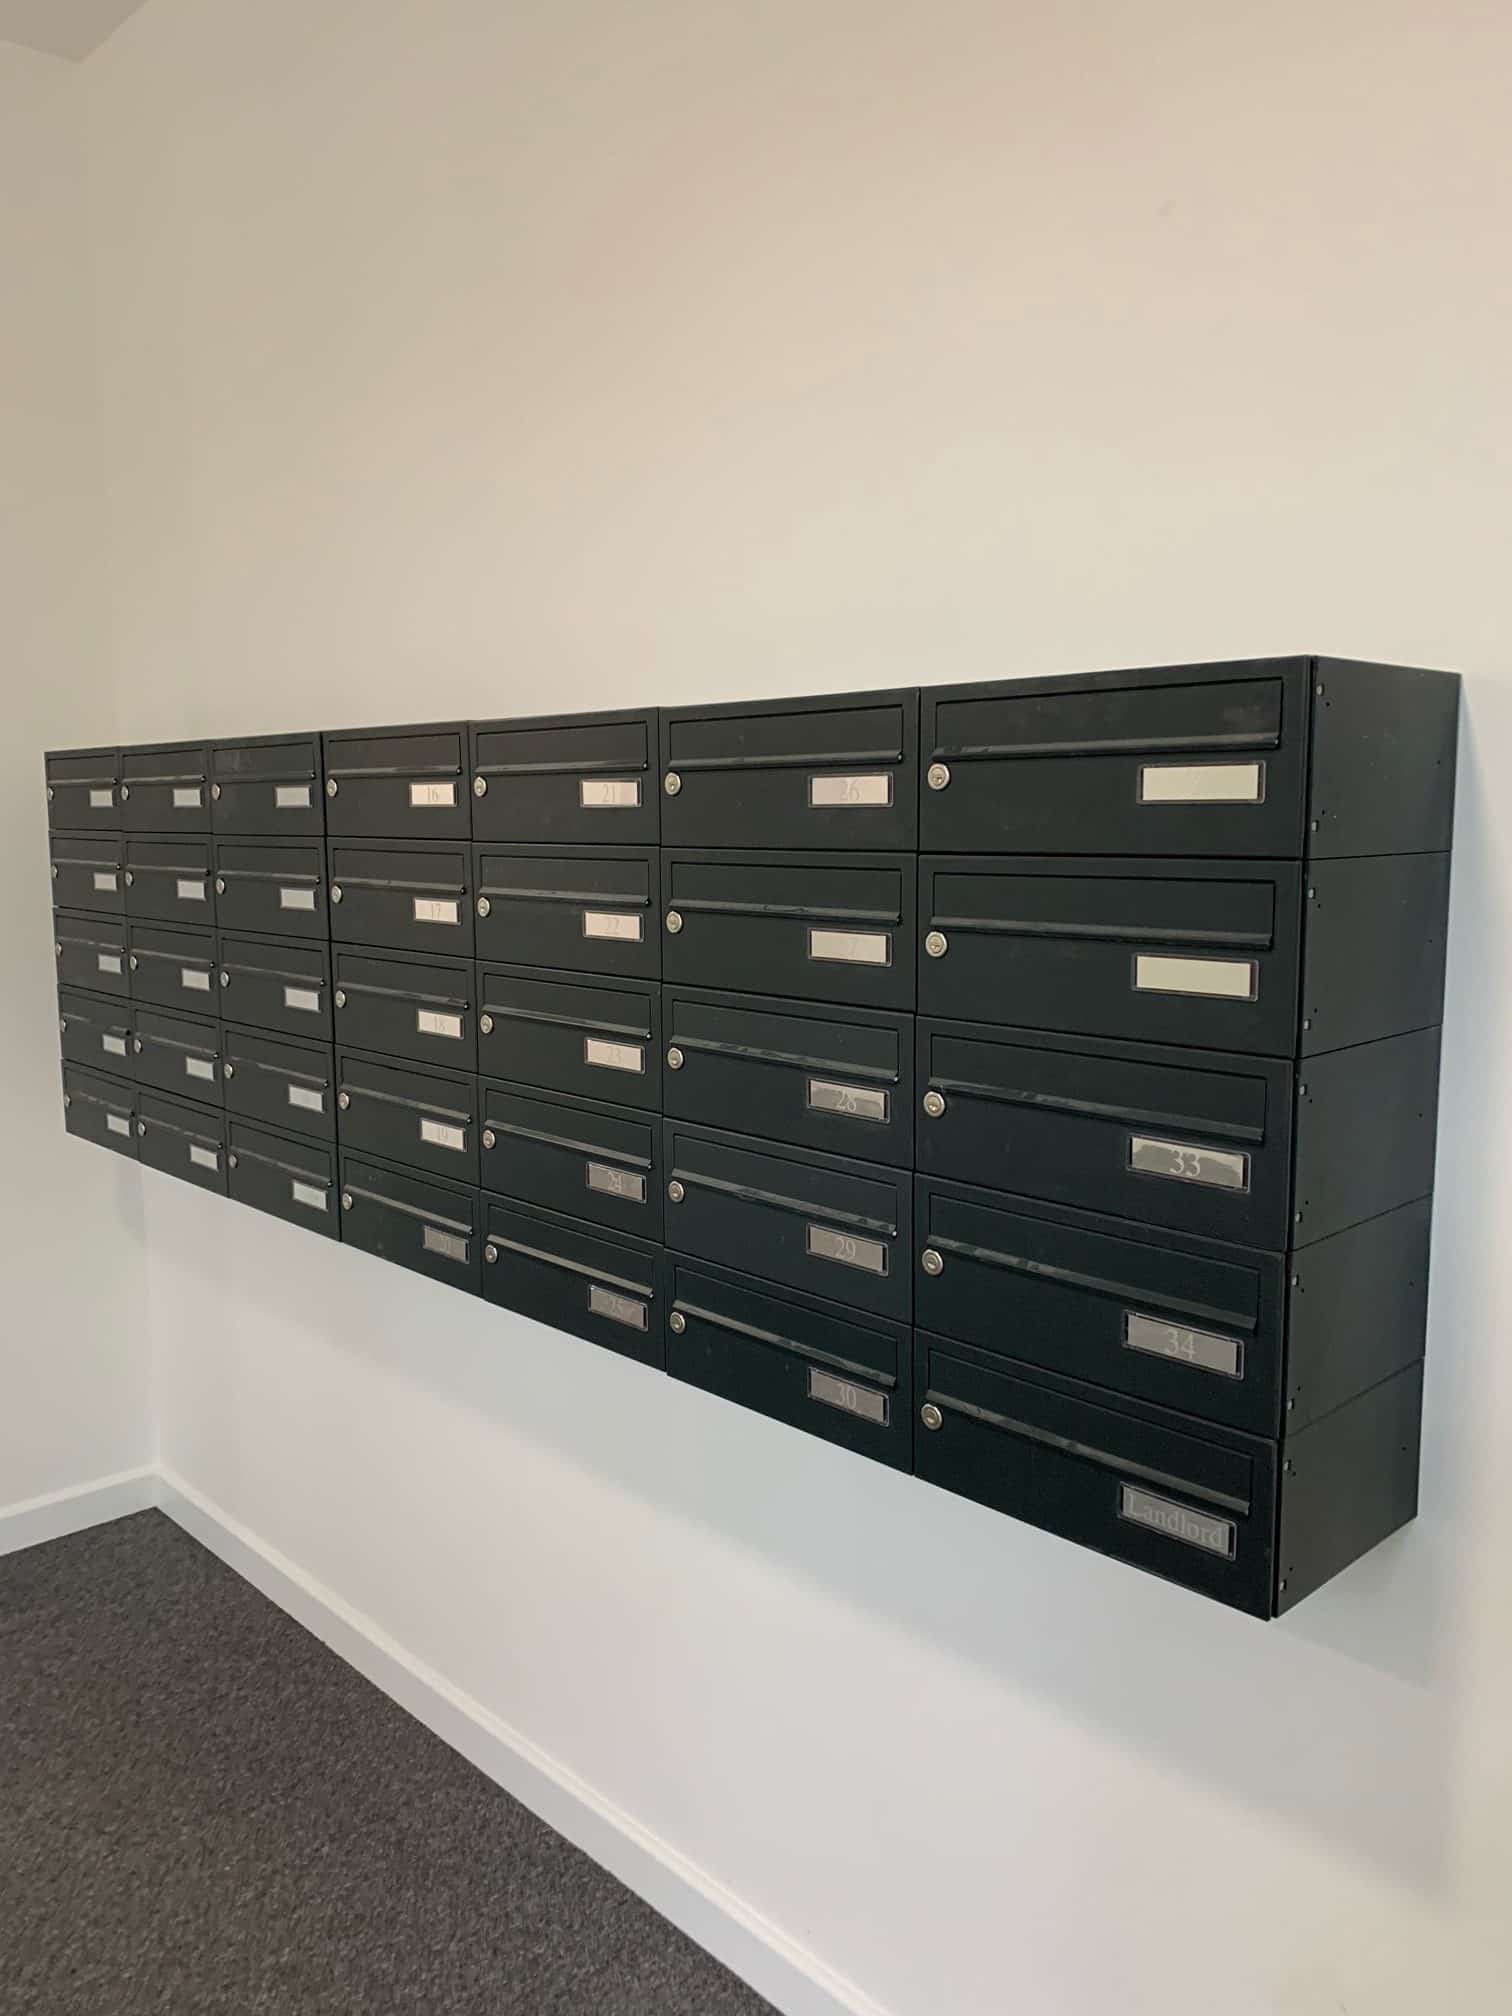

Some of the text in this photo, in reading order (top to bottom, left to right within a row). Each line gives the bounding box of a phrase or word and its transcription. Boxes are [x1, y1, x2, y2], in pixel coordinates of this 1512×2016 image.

[600, 782, 616, 803] 21
[840, 779, 862, 802] 26
[836, 1089, 857, 1112] 28
[1168, 1149, 1201, 1179] 33
[836, 1237, 857, 1262] 29
[1167, 1328, 1196, 1359] 34
[838, 1382, 856, 1411] 30
[1127, 1490, 1227, 1552] Landlord
